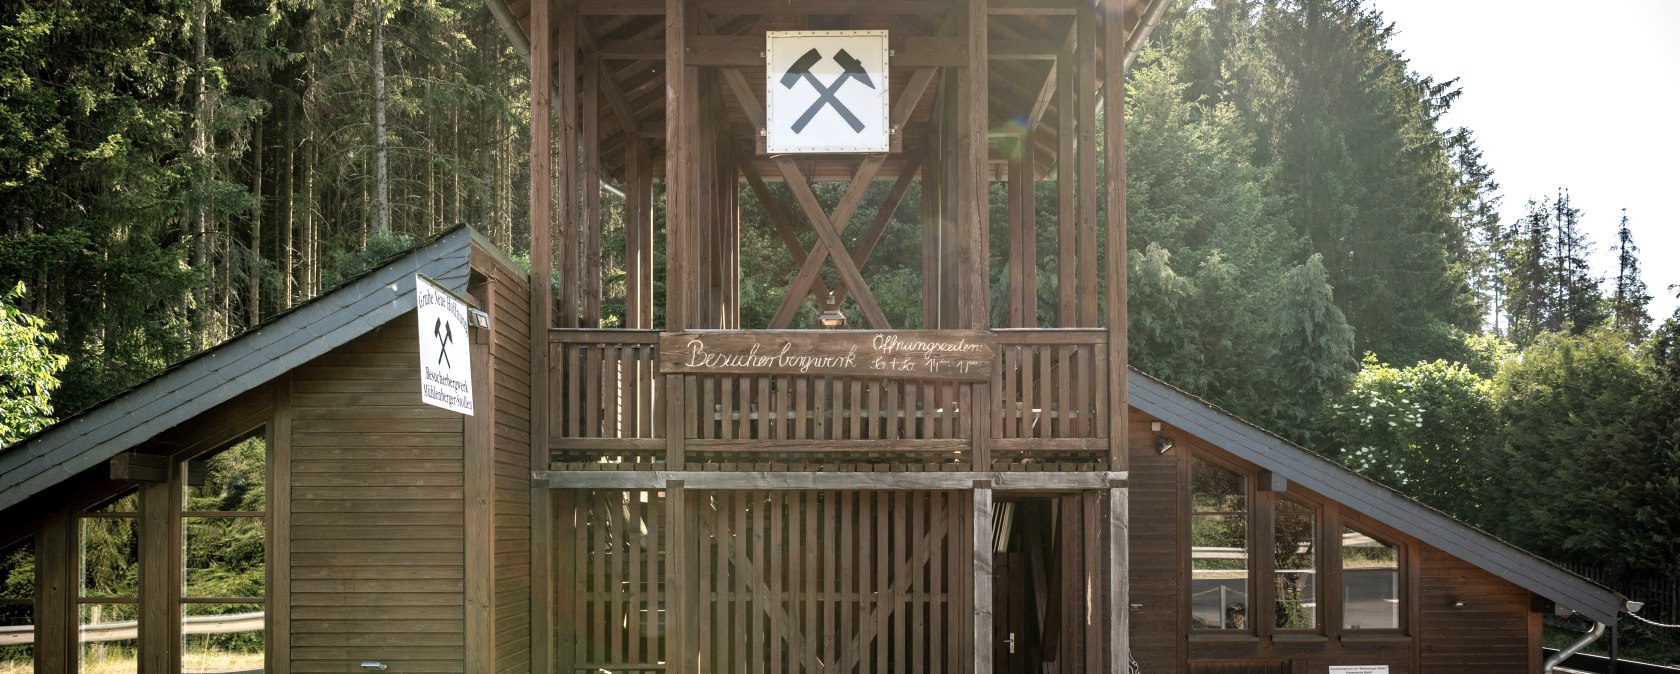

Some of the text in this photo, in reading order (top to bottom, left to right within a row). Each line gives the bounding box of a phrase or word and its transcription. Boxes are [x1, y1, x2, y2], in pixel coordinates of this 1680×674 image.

[418, 288, 434, 309] Grube
[685, 340, 857, 373] Besucherbergwerk
[425, 366, 469, 393] Besucherbergwerk
